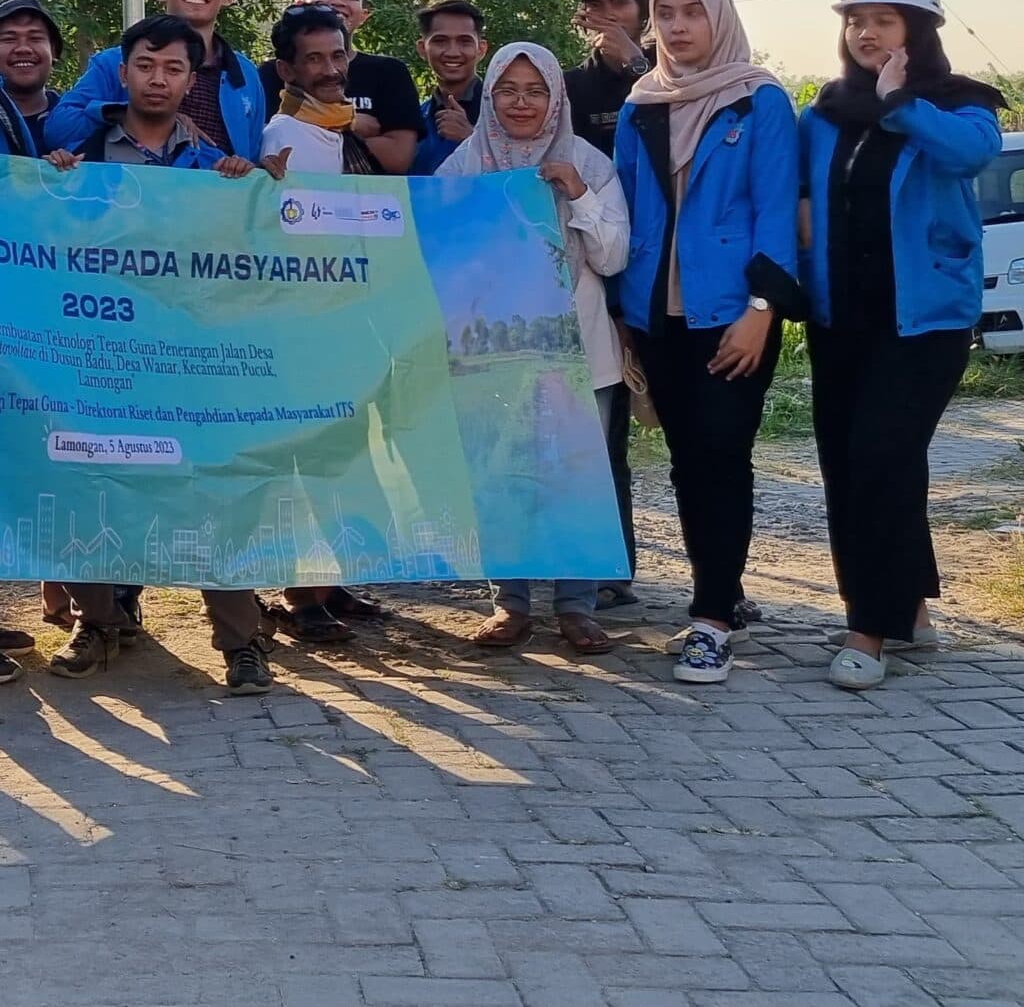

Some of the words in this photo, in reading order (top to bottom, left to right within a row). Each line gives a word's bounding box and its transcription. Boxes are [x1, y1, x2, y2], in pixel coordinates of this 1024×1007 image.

[67, 247, 179, 278] KEPADA
[191, 252, 369, 282] MASYARAKAT
[62, 293, 135, 322] 2023
[46, 330, 95, 355] Teknologi
[97, 335, 126, 353] Tepat
[129, 339, 156, 356] Guna
[159, 341, 219, 361] Penerangan
[221, 344, 246, 362] Jalan
[248, 344, 274, 360] Desa
[39, 347, 49, 362] di
[52, 349, 83, 367] Dusun
[86, 352, 115, 371] Badu,
[117, 355, 141, 371] Desa
[143, 357, 181, 375] Wanar,
[184, 360, 238, 377] Kecamatan
[8, 393, 39, 414] Tepat
[41, 395, 68, 413] Guna
[77, 399, 126, 419] Direktorat
[128, 405, 153, 420] Riset
[156, 406, 175, 421] dan
[176, 406, 235, 426] Pengabdian
[237, 407, 274, 425] kepada
[276, 404, 335, 424] Masyarakat
[335, 401, 355, 418] ITS
[55, 435, 108, 458] Lamongan,
[109, 439, 116, 453] 5
[117, 439, 153, 459] Agustus
[154, 440, 175, 454] 2023
